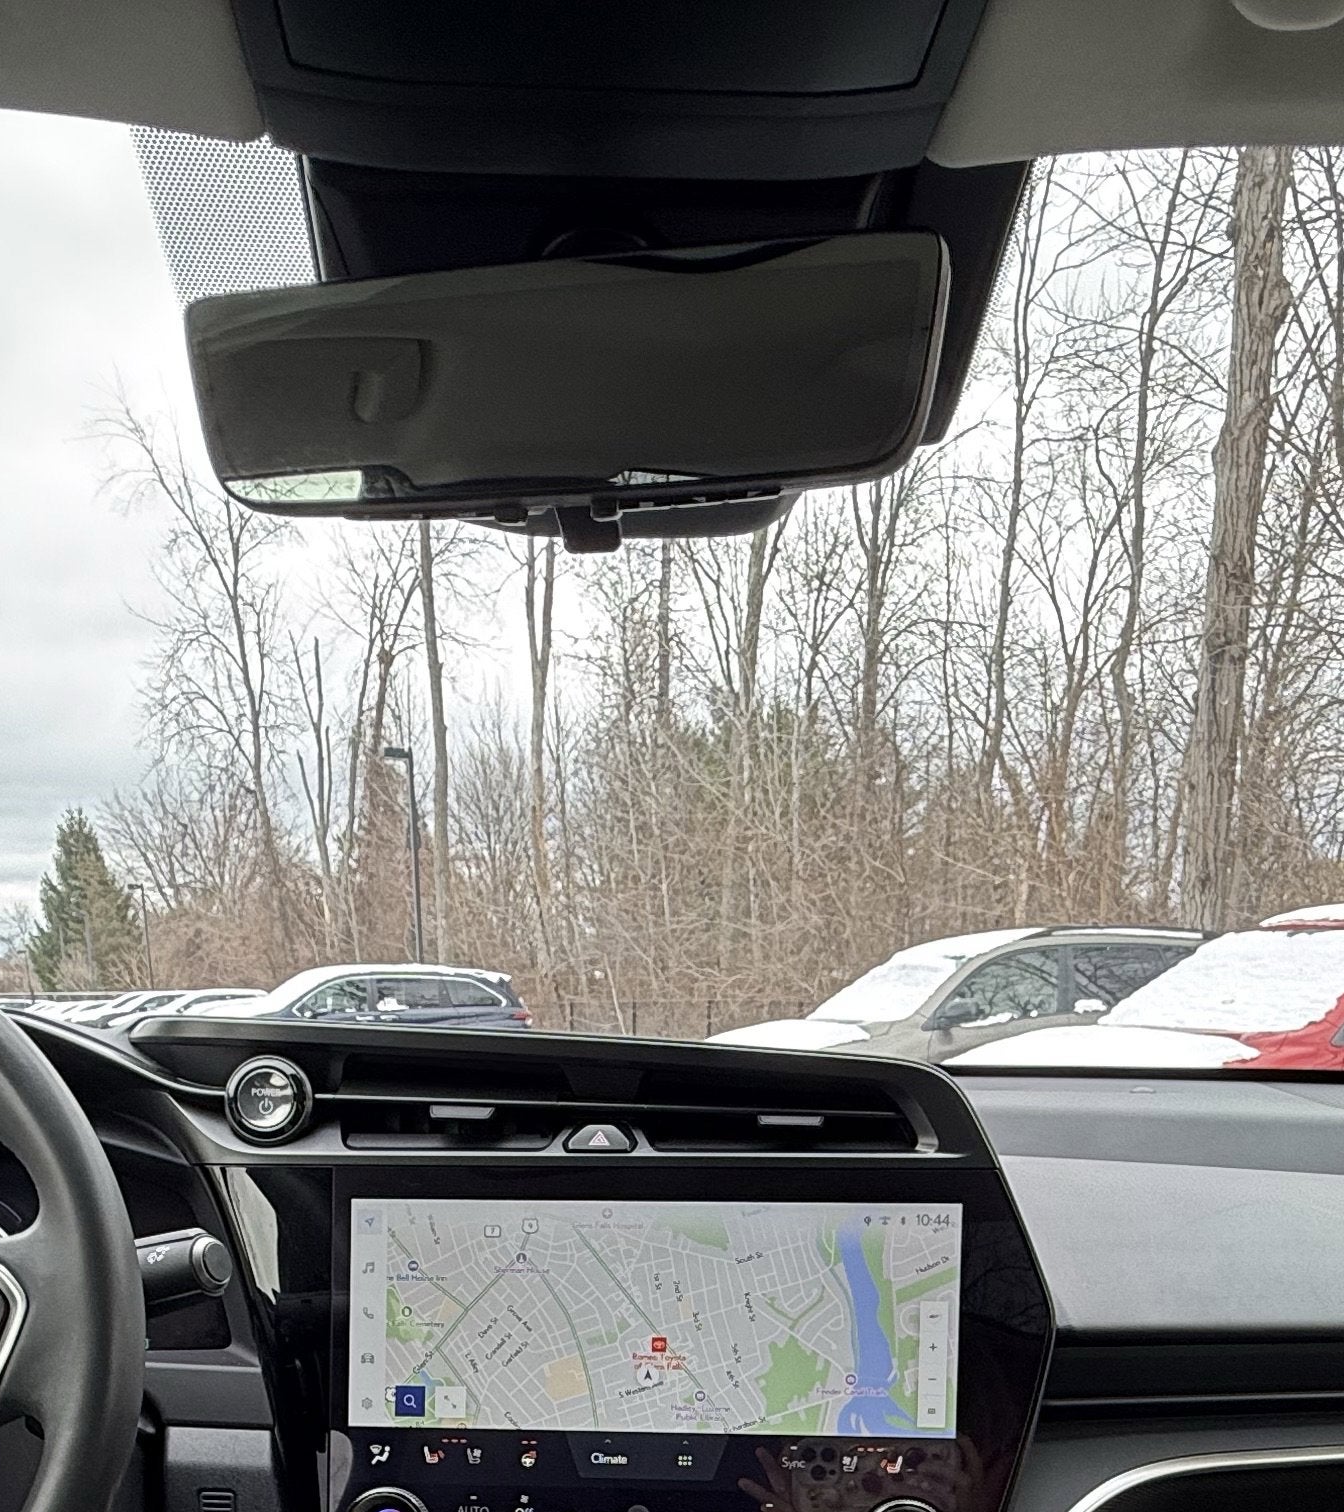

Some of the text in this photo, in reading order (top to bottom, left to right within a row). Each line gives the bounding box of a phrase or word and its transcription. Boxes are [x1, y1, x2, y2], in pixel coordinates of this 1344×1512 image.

[916, 1214, 950, 1226] 10:44
[590, 1452, 628, 1465] Climate
[781, 1456, 806, 1471] Sync
